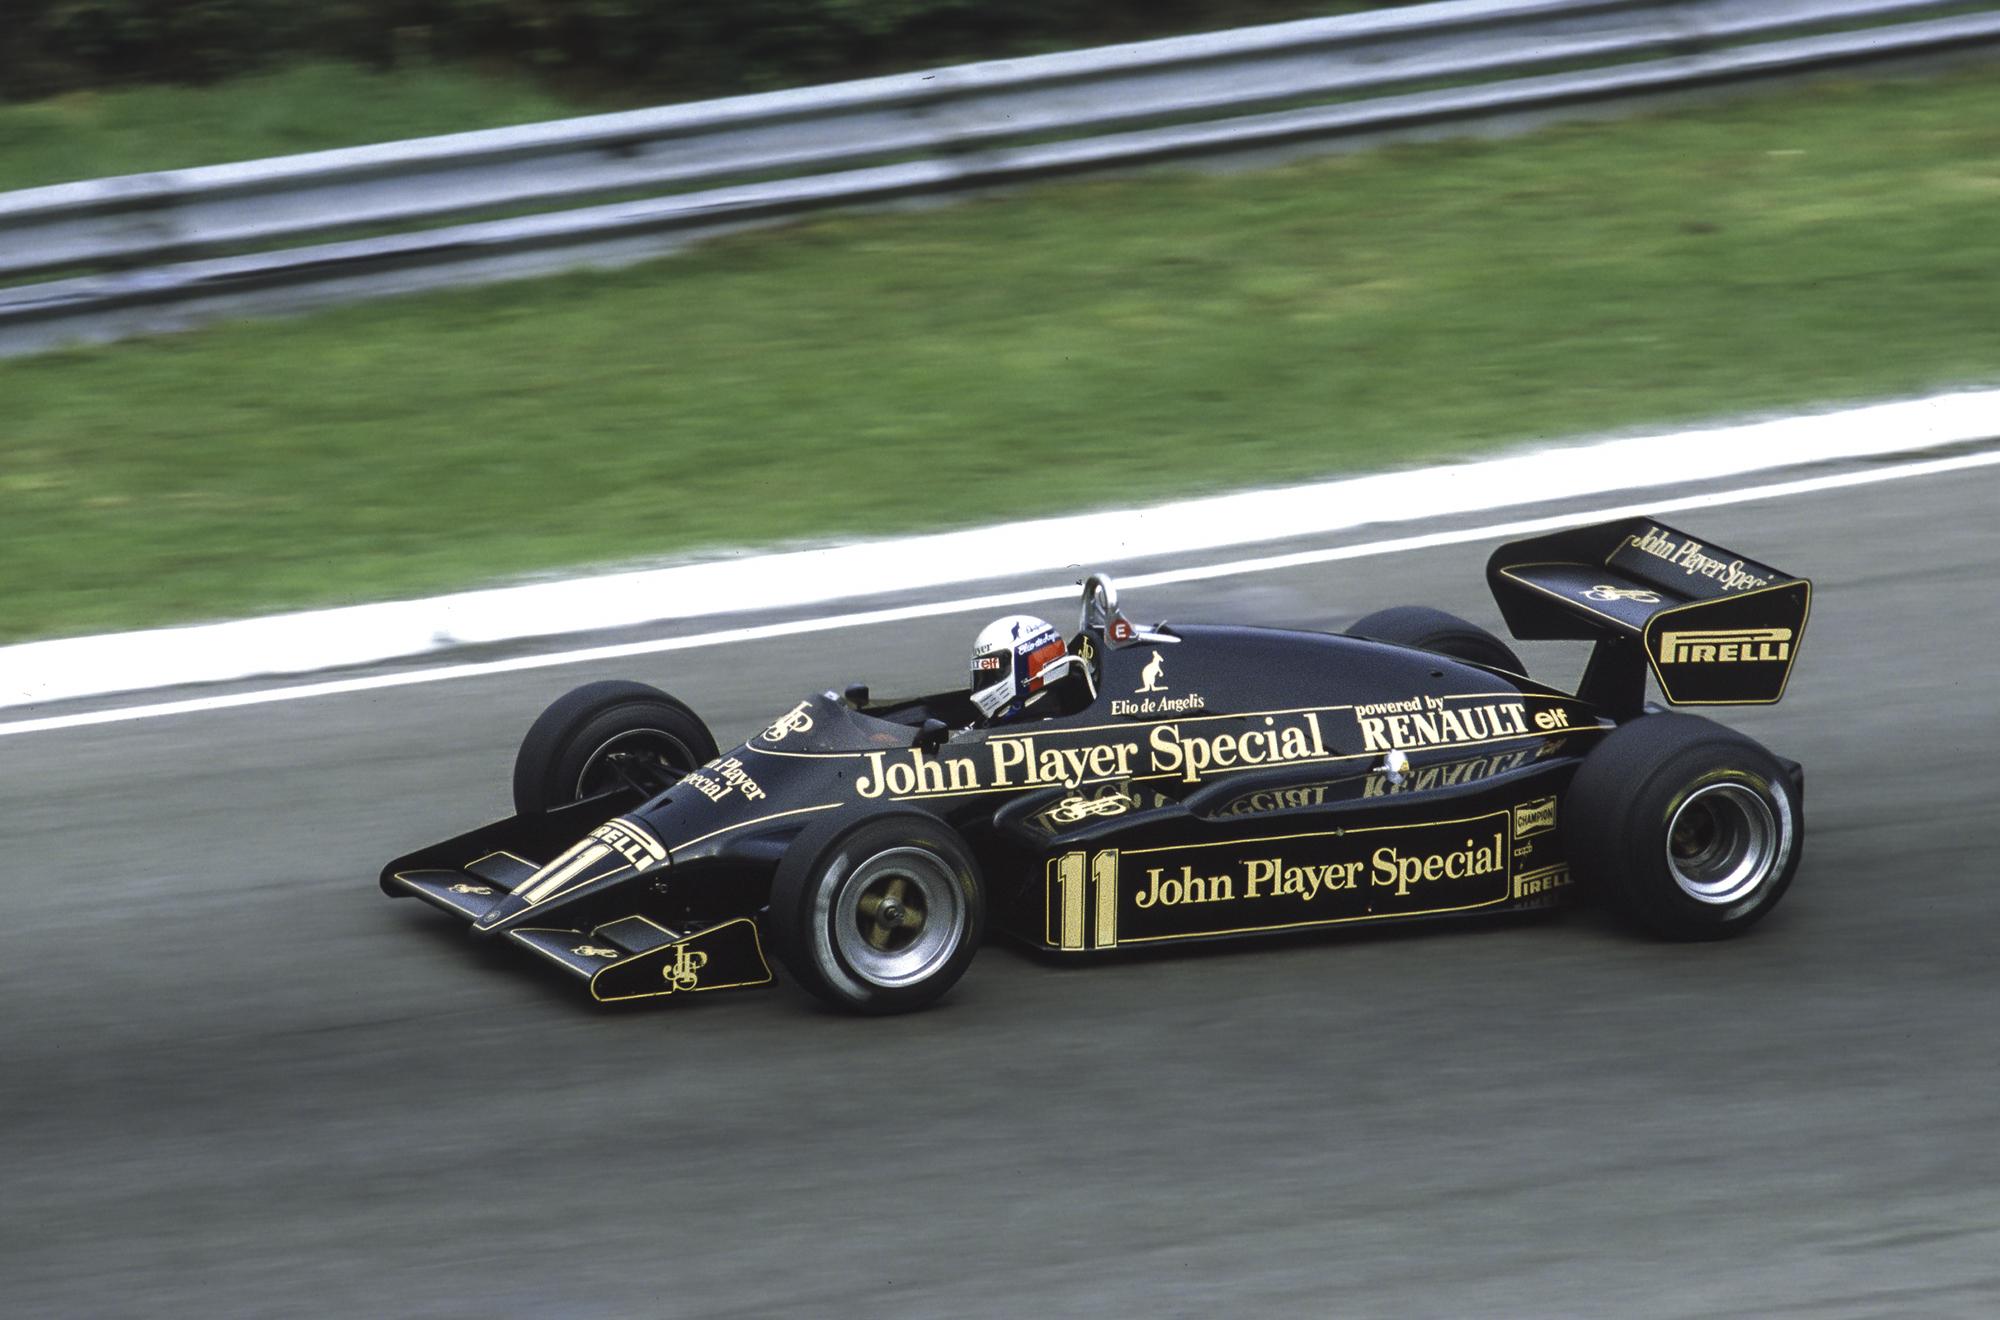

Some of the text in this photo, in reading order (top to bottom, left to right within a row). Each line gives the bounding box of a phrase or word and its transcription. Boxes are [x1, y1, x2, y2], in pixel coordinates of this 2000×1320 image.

[1631, 526, 1676, 559] John
[1668, 539, 1727, 578] Player
[1115, 624, 1126, 638] E
[1660, 628, 1792, 664] PIRELLI
[981, 657, 998, 669] elf
[1111, 693, 1205, 716] Elio de Angelis
[1354, 695, 1444, 720] powered by
[1534, 708, 1570, 730] elf
[1358, 703, 1529, 751] RENAULT
[856, 748, 981, 798] John
[985, 735, 1139, 789] Player
[1150, 712, 1329, 784] Special
[676, 772, 734, 803] pecial
[714, 757, 766, 801] Player
[1518, 808, 1554, 828] CHAMPION
[588, 817, 667, 872] RELLI
[1136, 832, 1504, 909] John Player Special
[1514, 862, 1575, 898] PIRELL
[1057, 848, 1119, 950] 11
